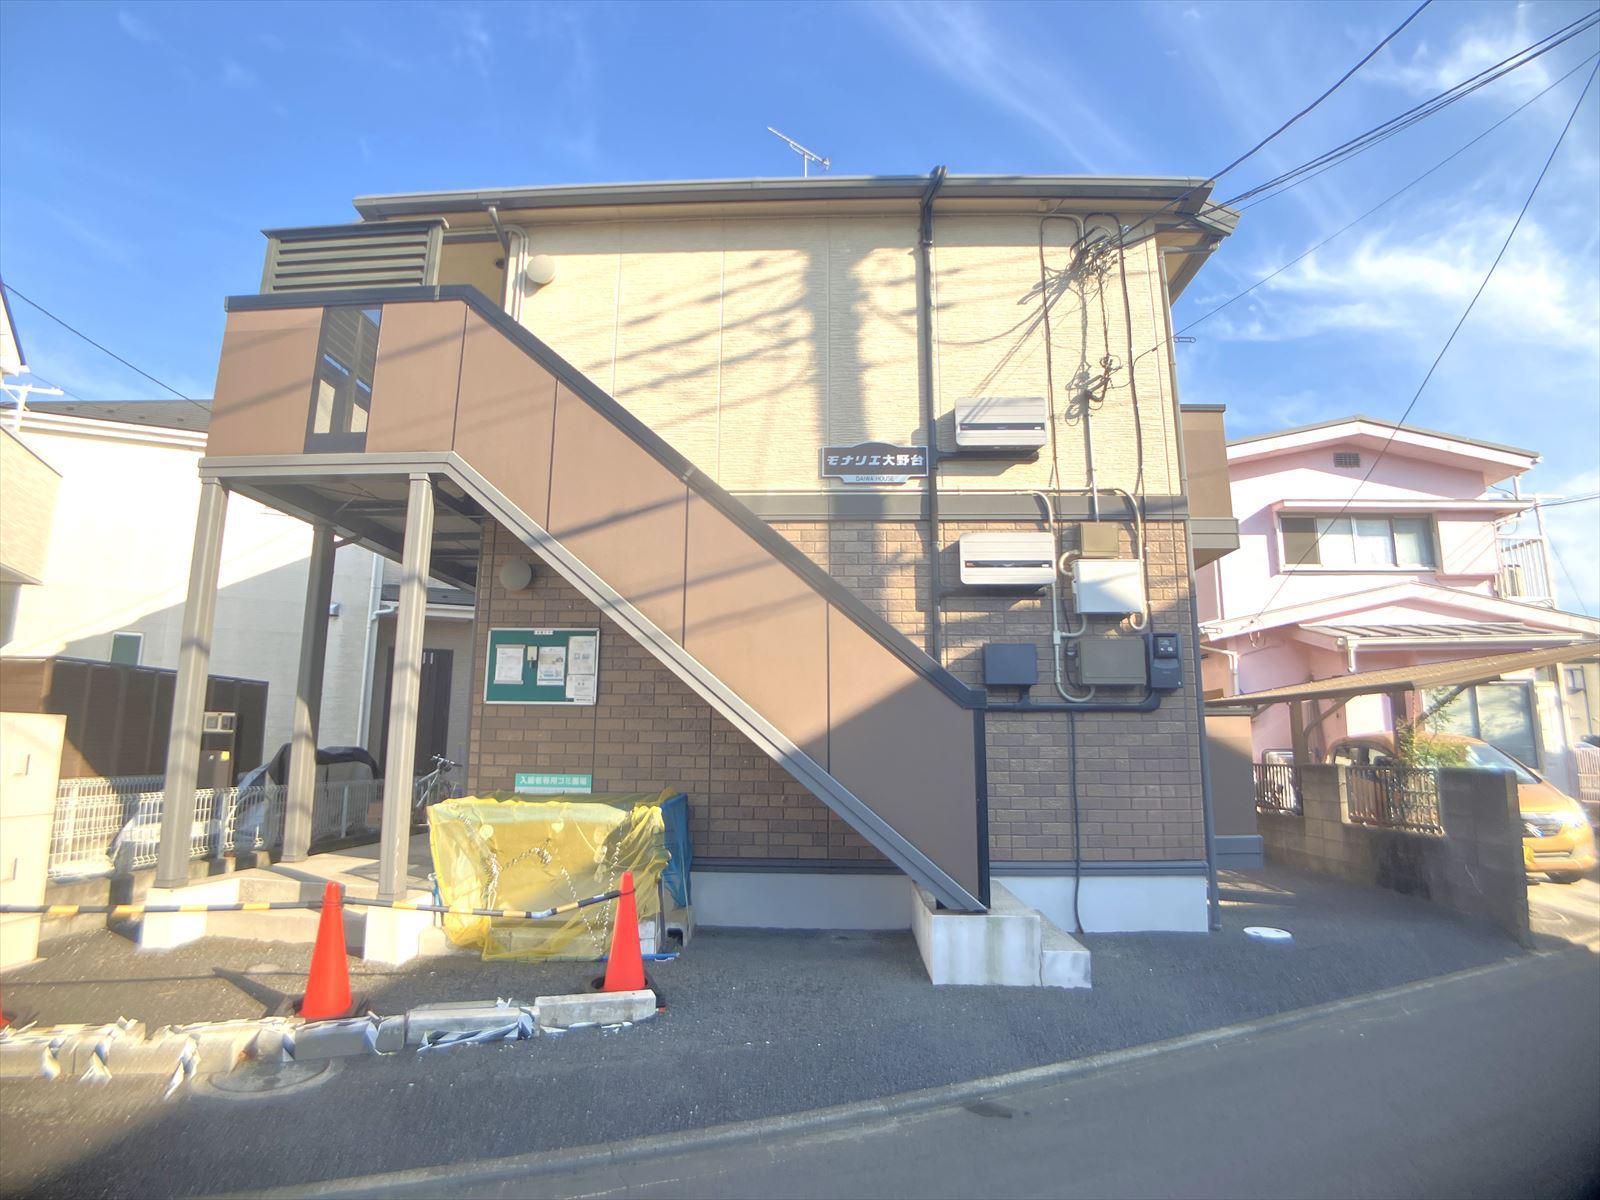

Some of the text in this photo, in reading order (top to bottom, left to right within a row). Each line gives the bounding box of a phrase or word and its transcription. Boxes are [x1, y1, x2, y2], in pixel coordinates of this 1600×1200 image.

[827, 454, 924, 466] モナリエ大野台
